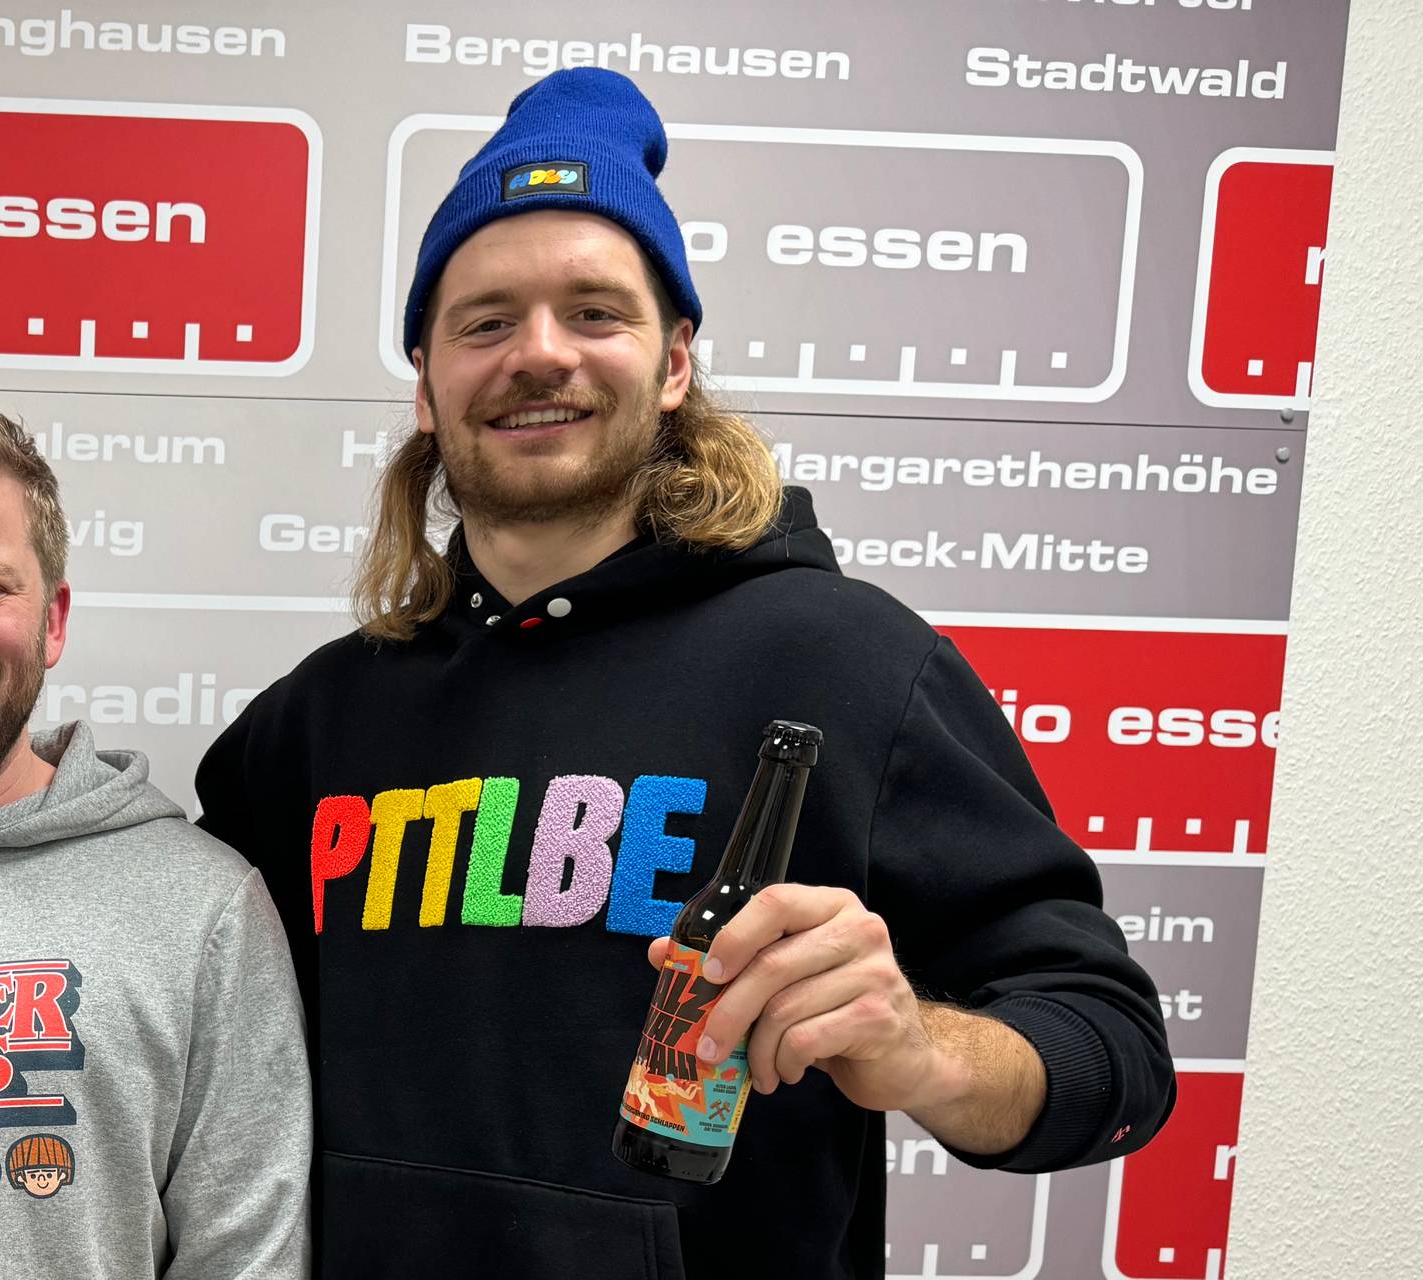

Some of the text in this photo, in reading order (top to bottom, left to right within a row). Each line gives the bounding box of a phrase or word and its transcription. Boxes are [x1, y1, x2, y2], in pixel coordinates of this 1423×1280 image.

[405, 24, 850, 80] Bergerhausen
[965, 47, 1287, 100] Stadtwald
[766, 224, 1028, 273] essen
[311, 775, 707, 937] PTTLBE
